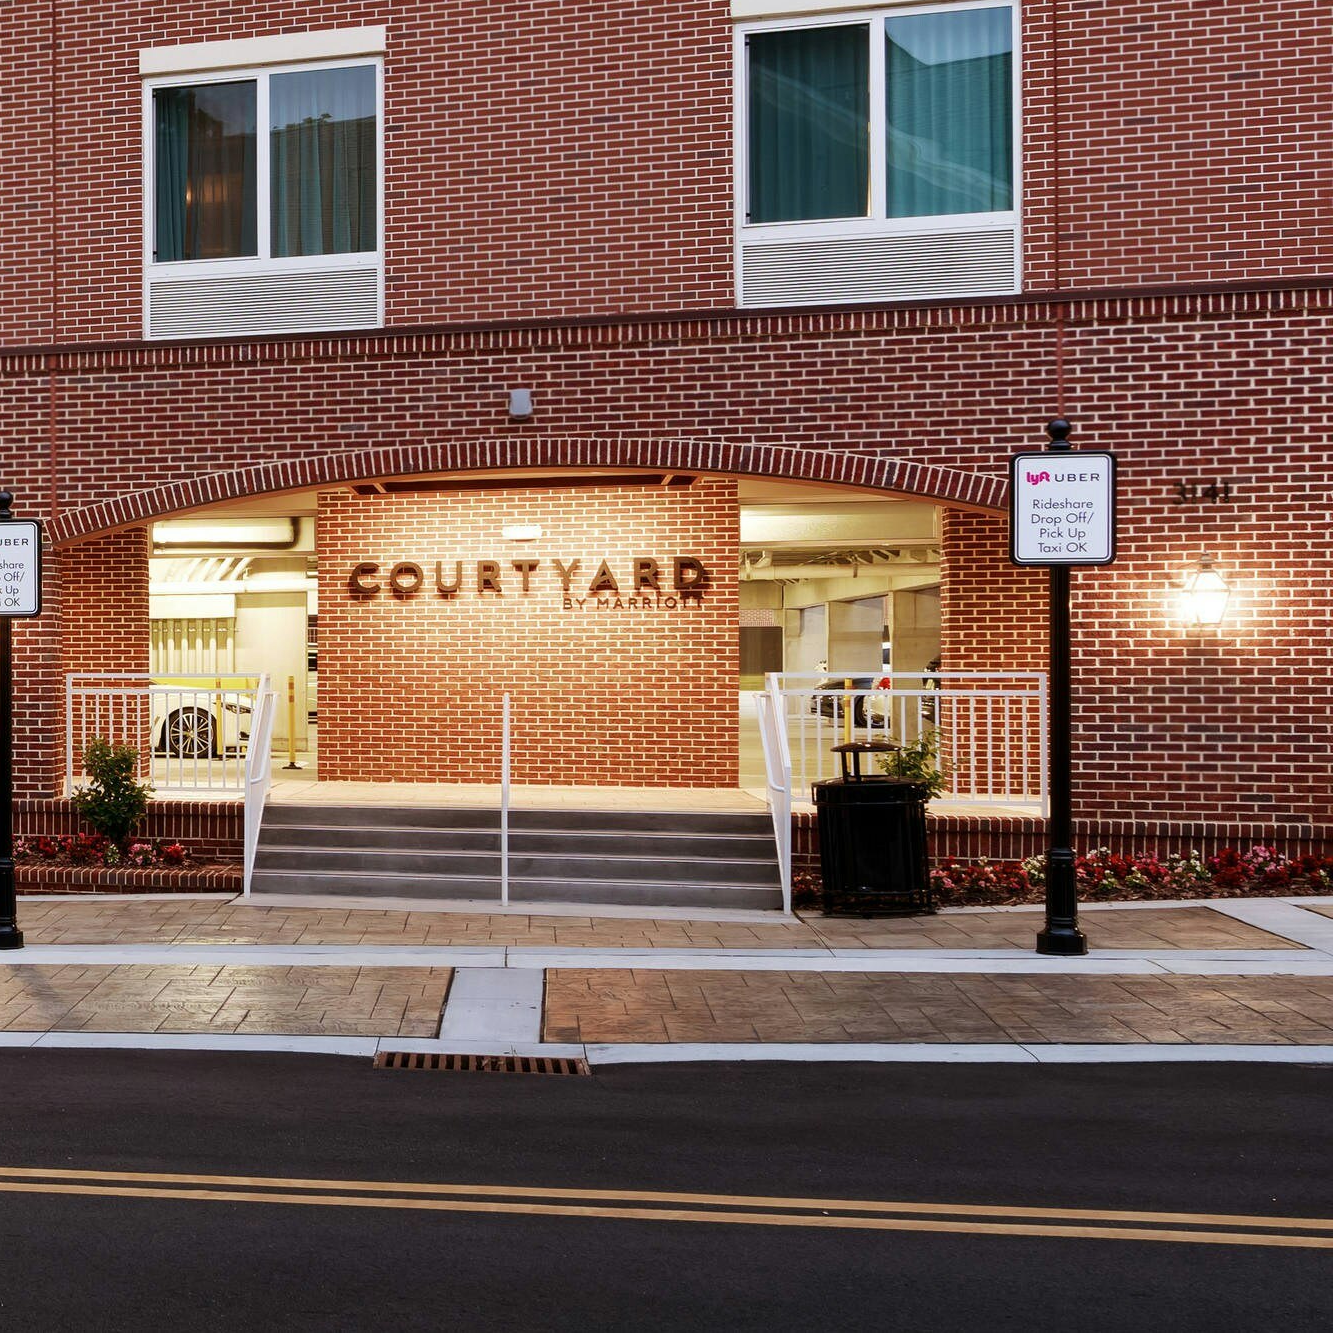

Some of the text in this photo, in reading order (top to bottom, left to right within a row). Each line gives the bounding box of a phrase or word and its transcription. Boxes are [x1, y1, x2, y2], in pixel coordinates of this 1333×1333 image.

[1026, 471, 1100, 485] lyft UBER
[1032, 498, 1093, 509] Rideshare
[1031, 511, 1094, 526] Drop Off/
[1039, 527, 1086, 541] Pick Up
[1038, 542, 1087, 553] Taxi OK
[3, 571, 25, 582] Off/
[351, 555, 705, 593] COURTYARD
[5, 586, 19, 597] Up
[4, 597, 20, 607] OK
[563, 597, 704, 610] BY MARRIOTT
